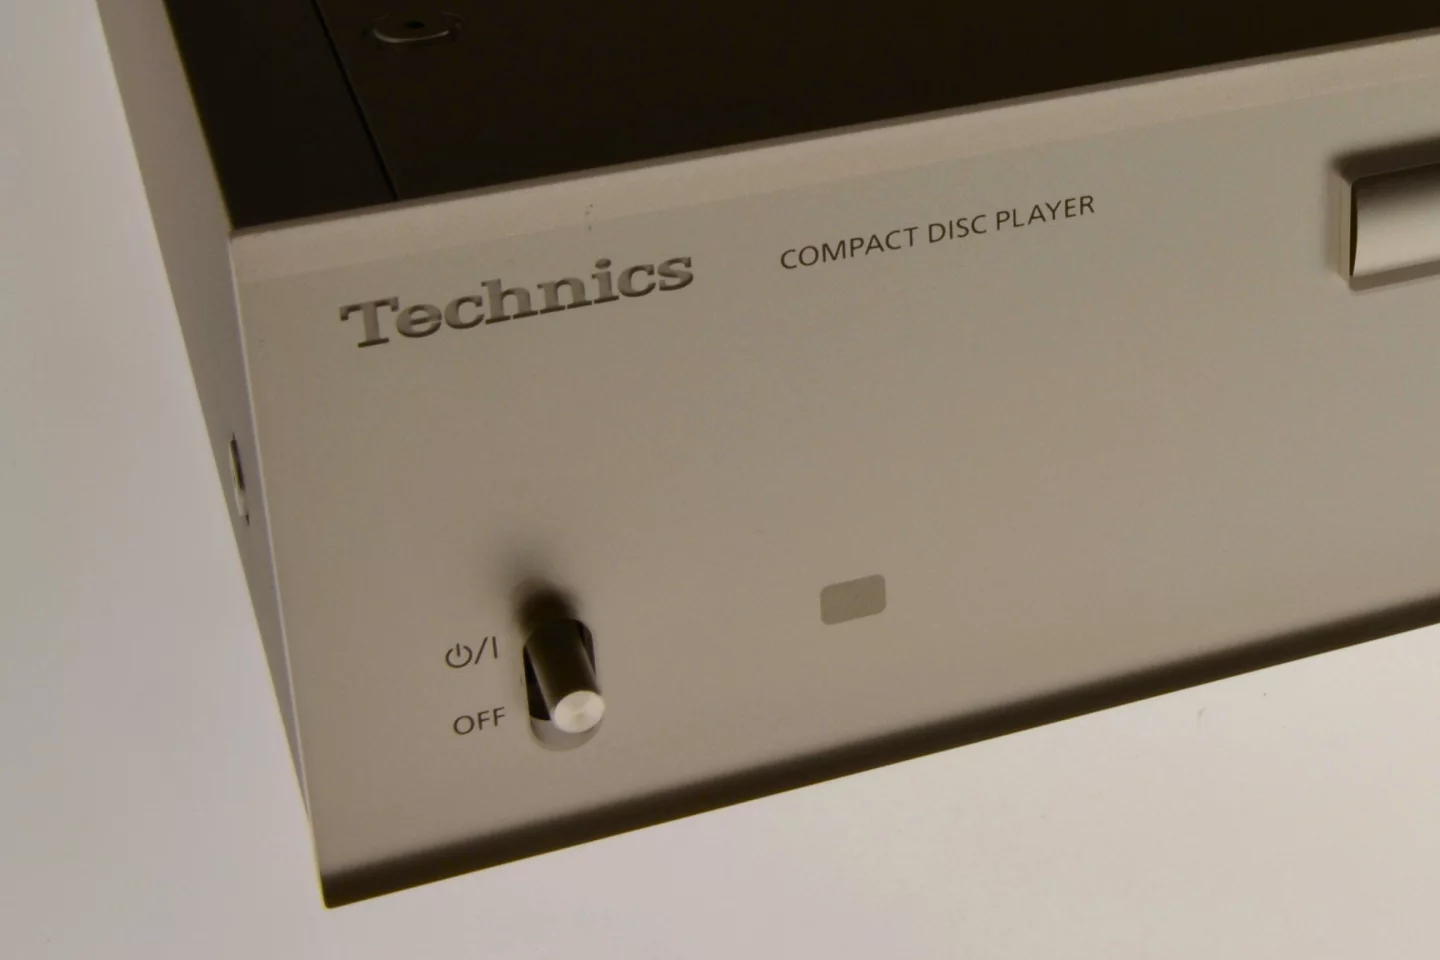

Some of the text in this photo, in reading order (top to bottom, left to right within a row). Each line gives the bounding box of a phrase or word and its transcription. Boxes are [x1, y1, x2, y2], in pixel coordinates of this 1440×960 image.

[780, 195, 1096, 270] COMPACT DISC PLAYER
[339, 255, 695, 348] Technics
[453, 707, 505, 735] OFF
